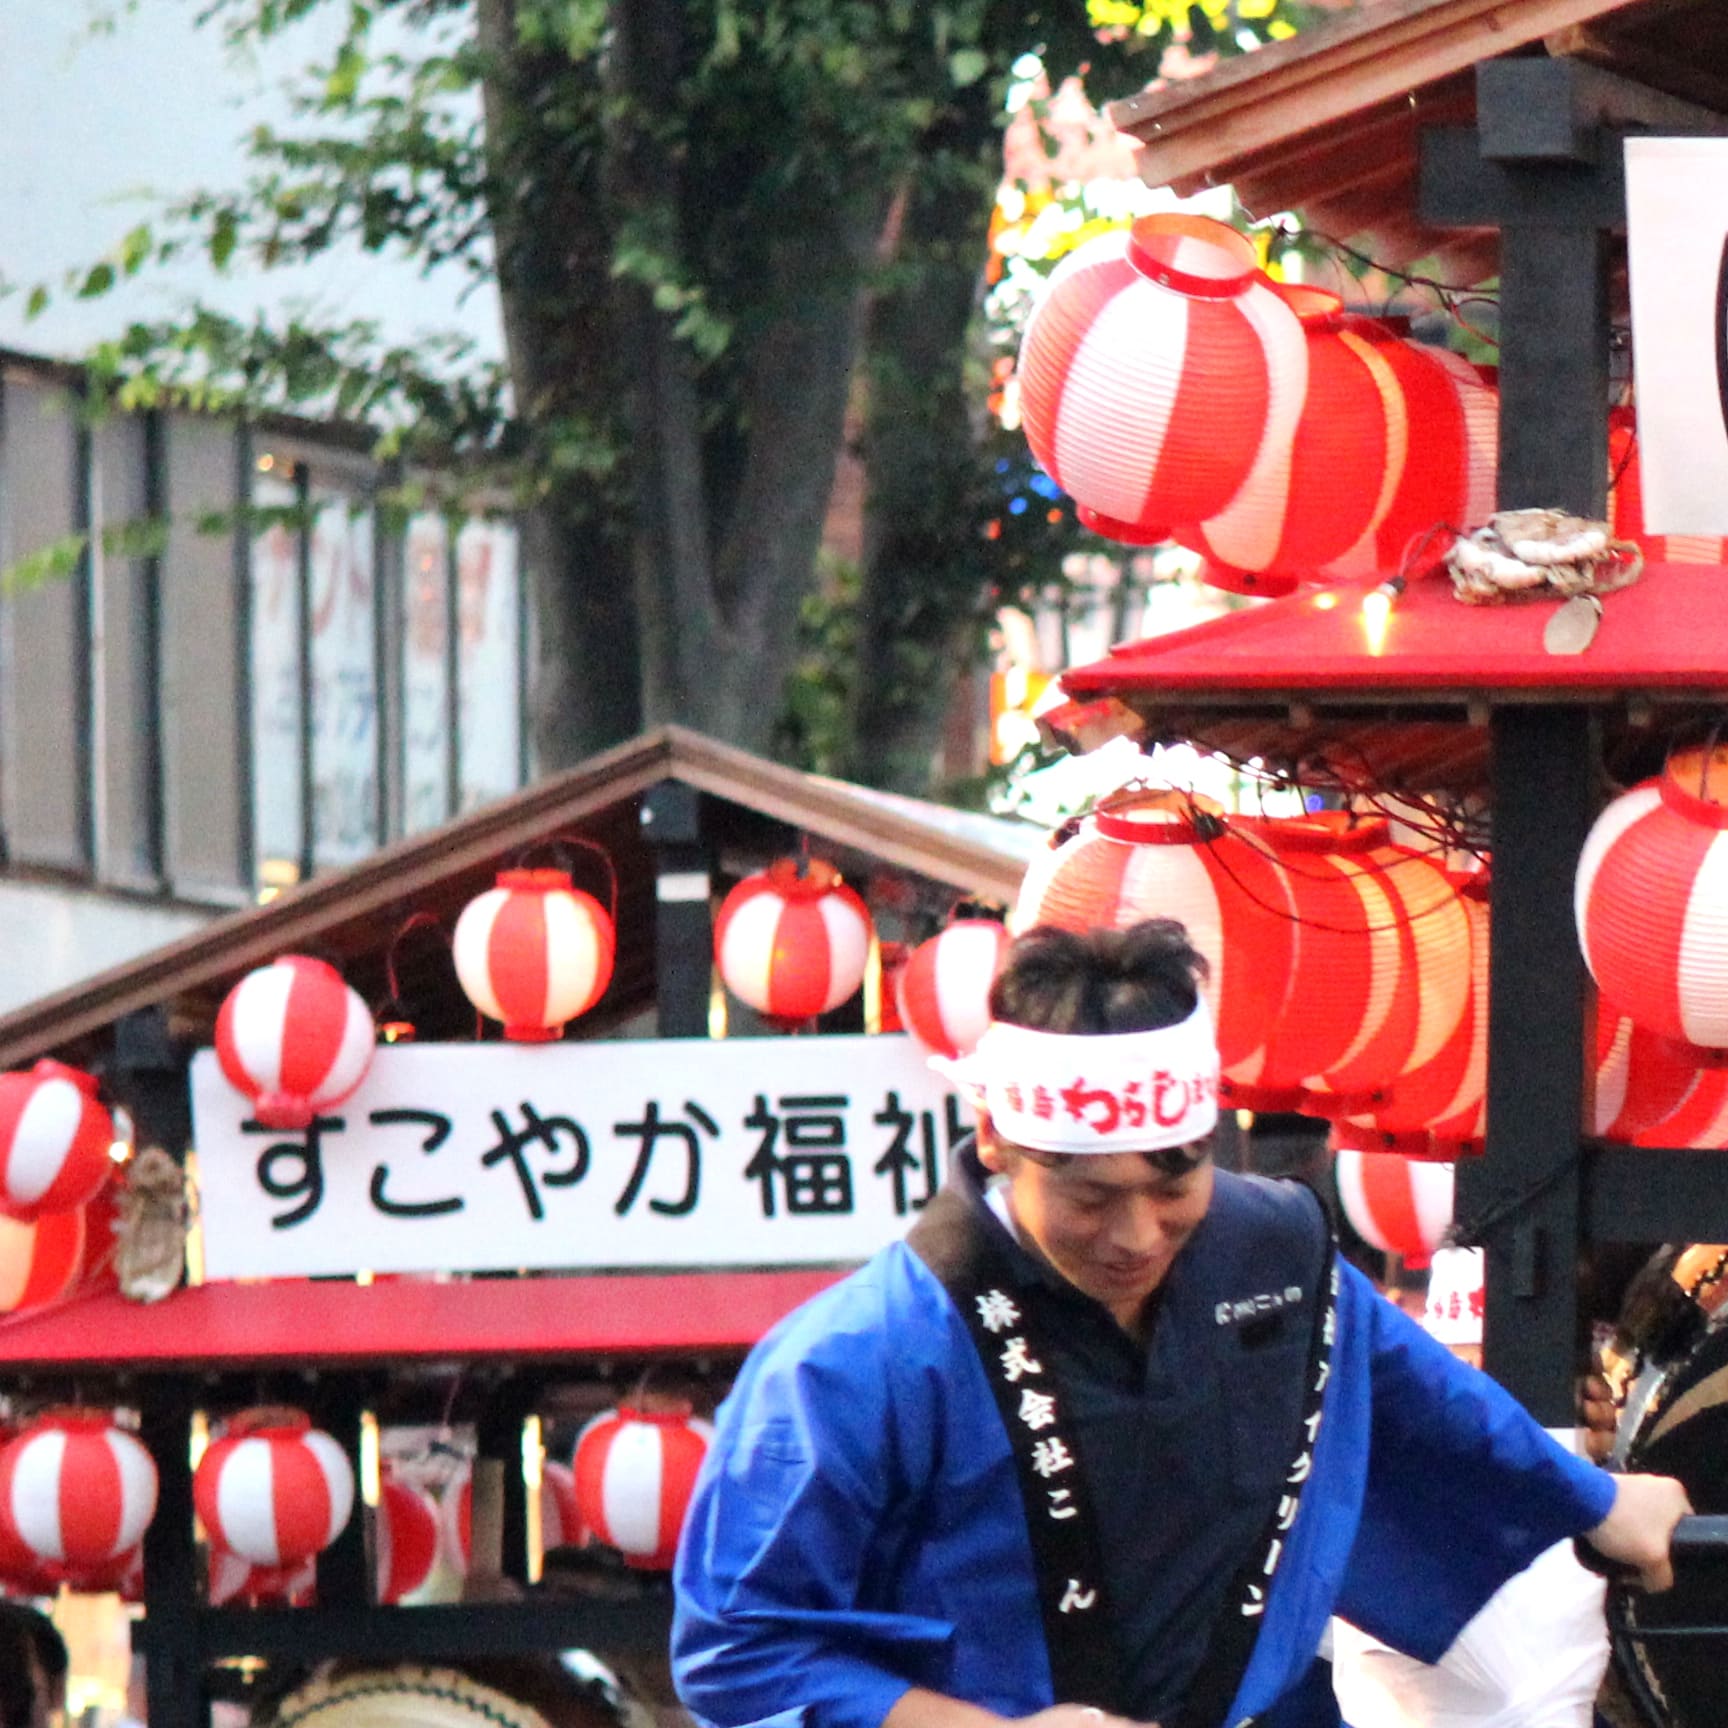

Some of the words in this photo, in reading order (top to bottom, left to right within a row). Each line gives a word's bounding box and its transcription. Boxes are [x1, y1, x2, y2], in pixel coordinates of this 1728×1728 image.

[240, 1092, 973, 1230] すこやか福祉
